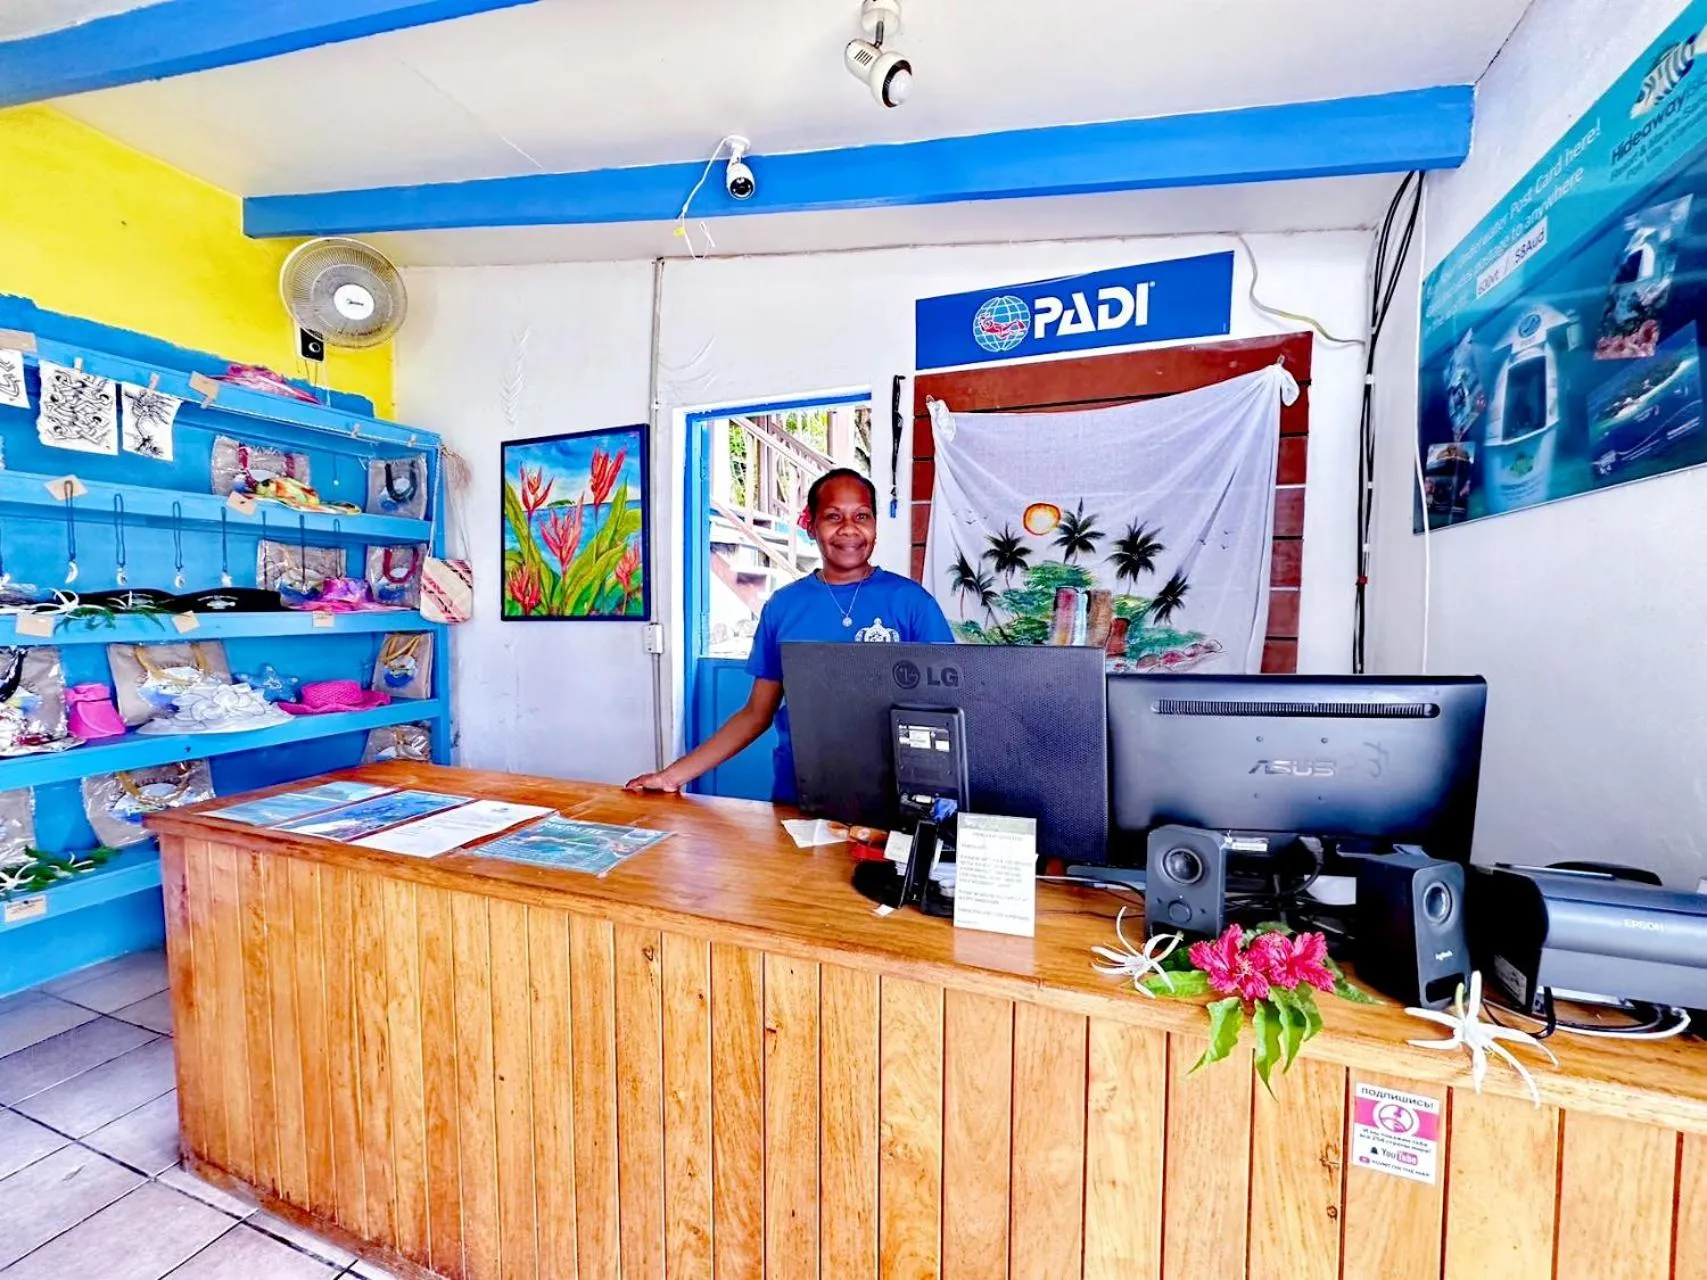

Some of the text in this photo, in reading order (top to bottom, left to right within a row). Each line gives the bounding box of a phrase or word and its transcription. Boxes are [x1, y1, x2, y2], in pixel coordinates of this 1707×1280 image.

[1610, 95, 1684, 166] Hideaway
[1510, 188, 1533, 219] Post
[1536, 155, 1562, 194] Card
[1565, 117, 1601, 166] here!
[1034, 281, 1149, 339] PADI
[926, 666, 959, 688] LG
[1248, 759, 1337, 777] ASUS
[1623, 918, 1665, 933] EPSON
